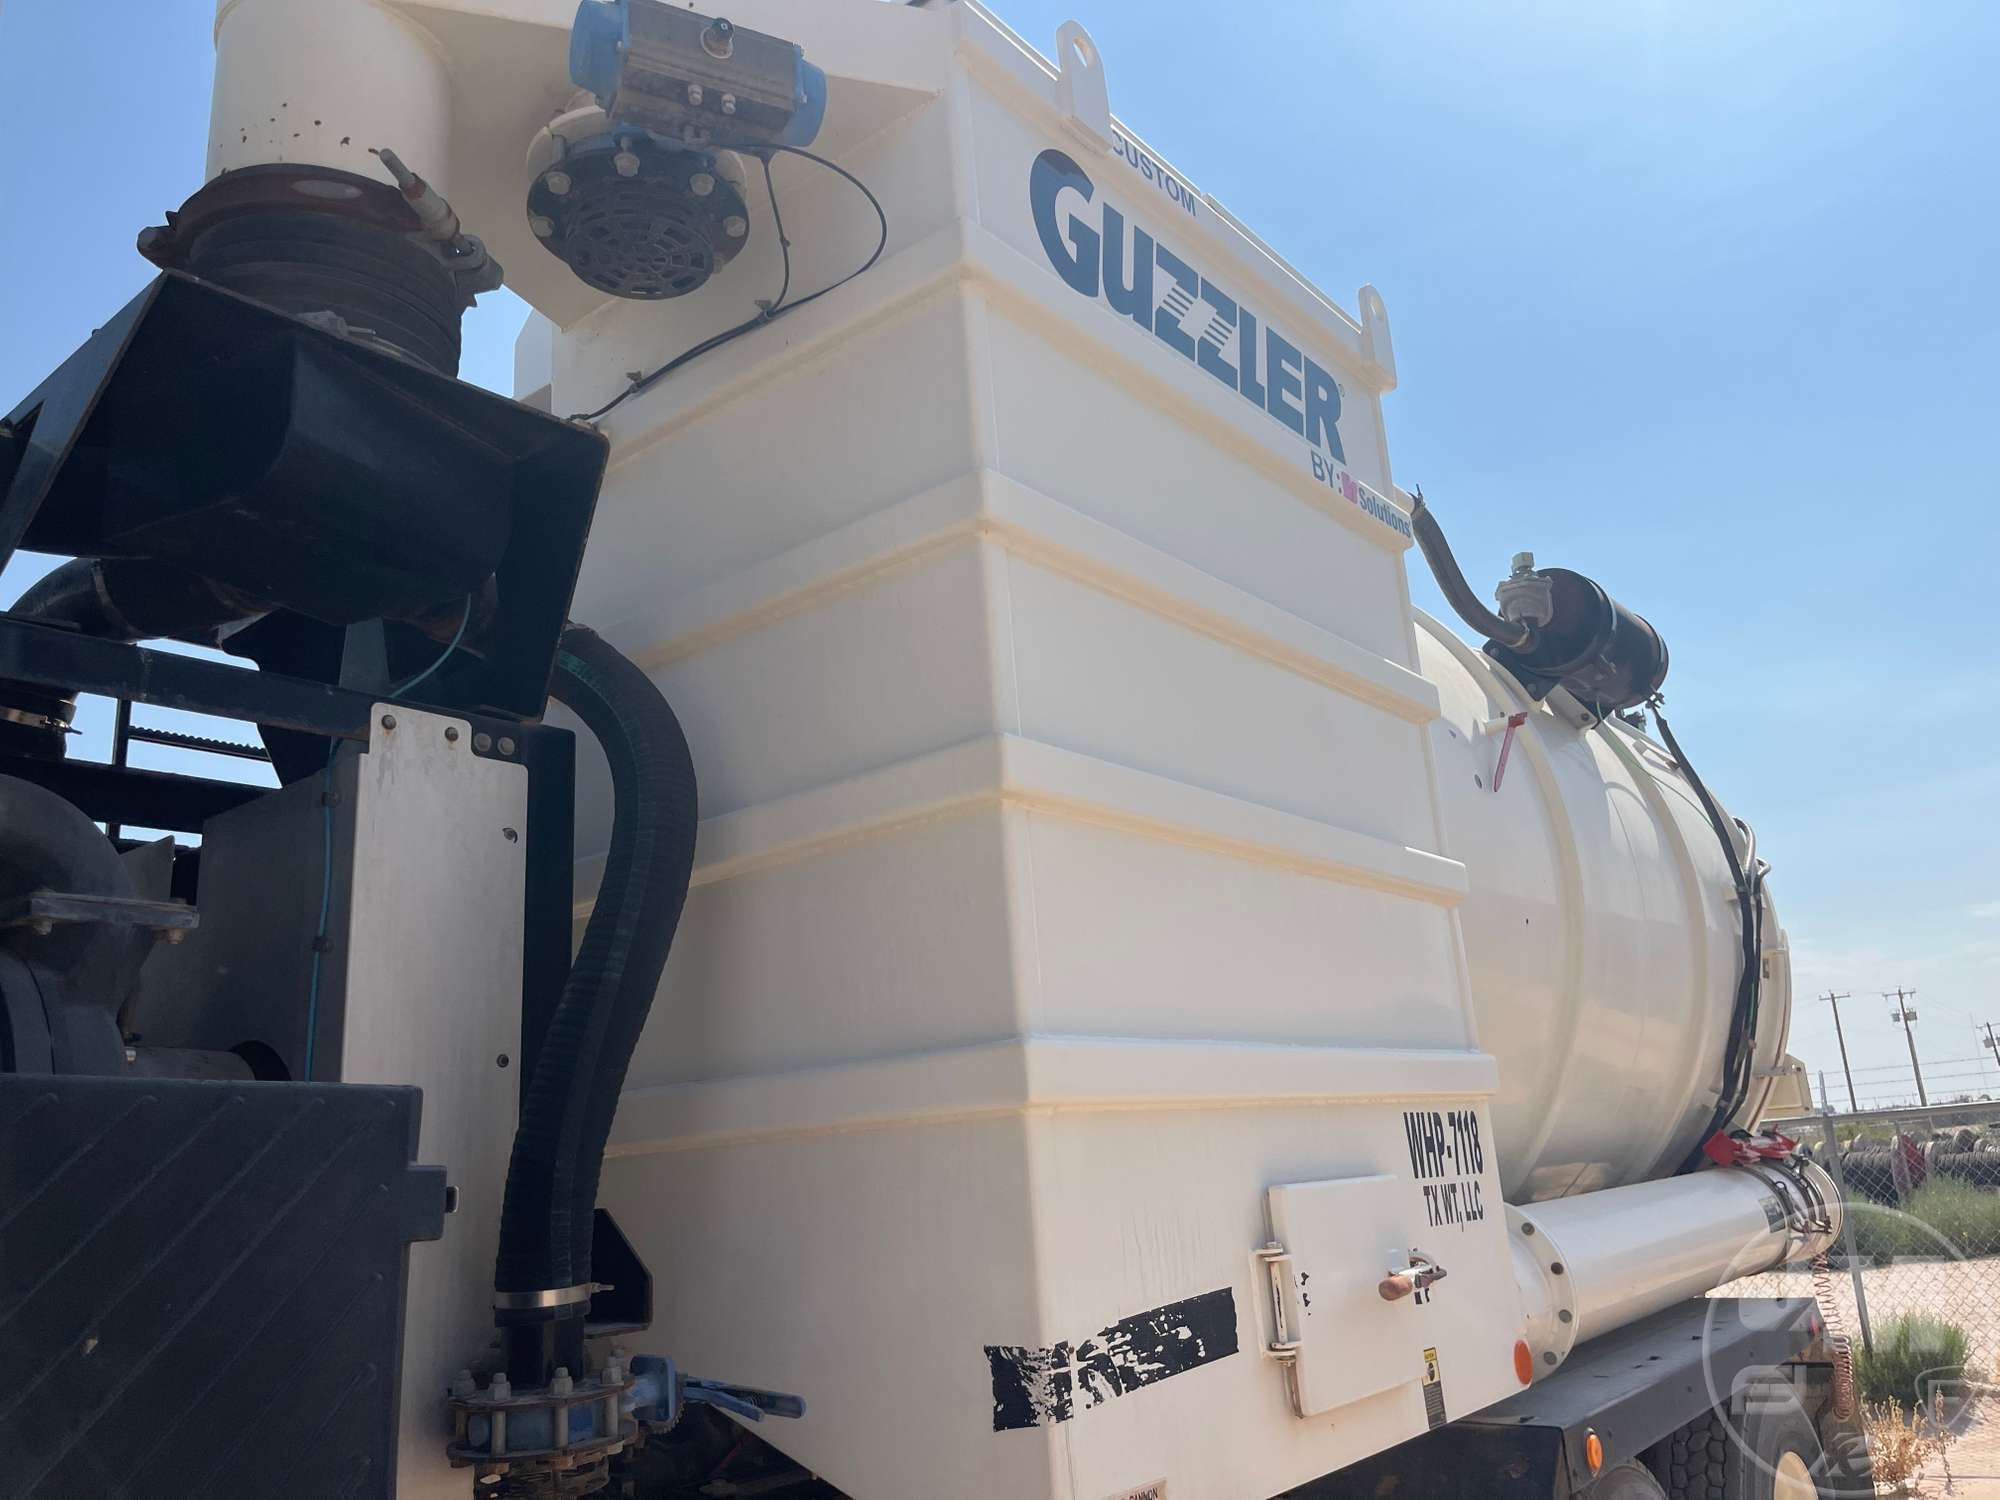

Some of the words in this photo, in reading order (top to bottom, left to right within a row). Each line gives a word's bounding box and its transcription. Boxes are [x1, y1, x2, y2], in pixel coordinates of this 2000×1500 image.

[1111, 129, 1197, 217] CUSTOM
[1029, 148, 1347, 466] GUZZLER
[1311, 449, 1342, 494] BY:
[1403, 1110, 1484, 1179] WHP-7118
[1423, 1185, 1443, 1227] TX
[1461, 1180, 1484, 1221] LLC
